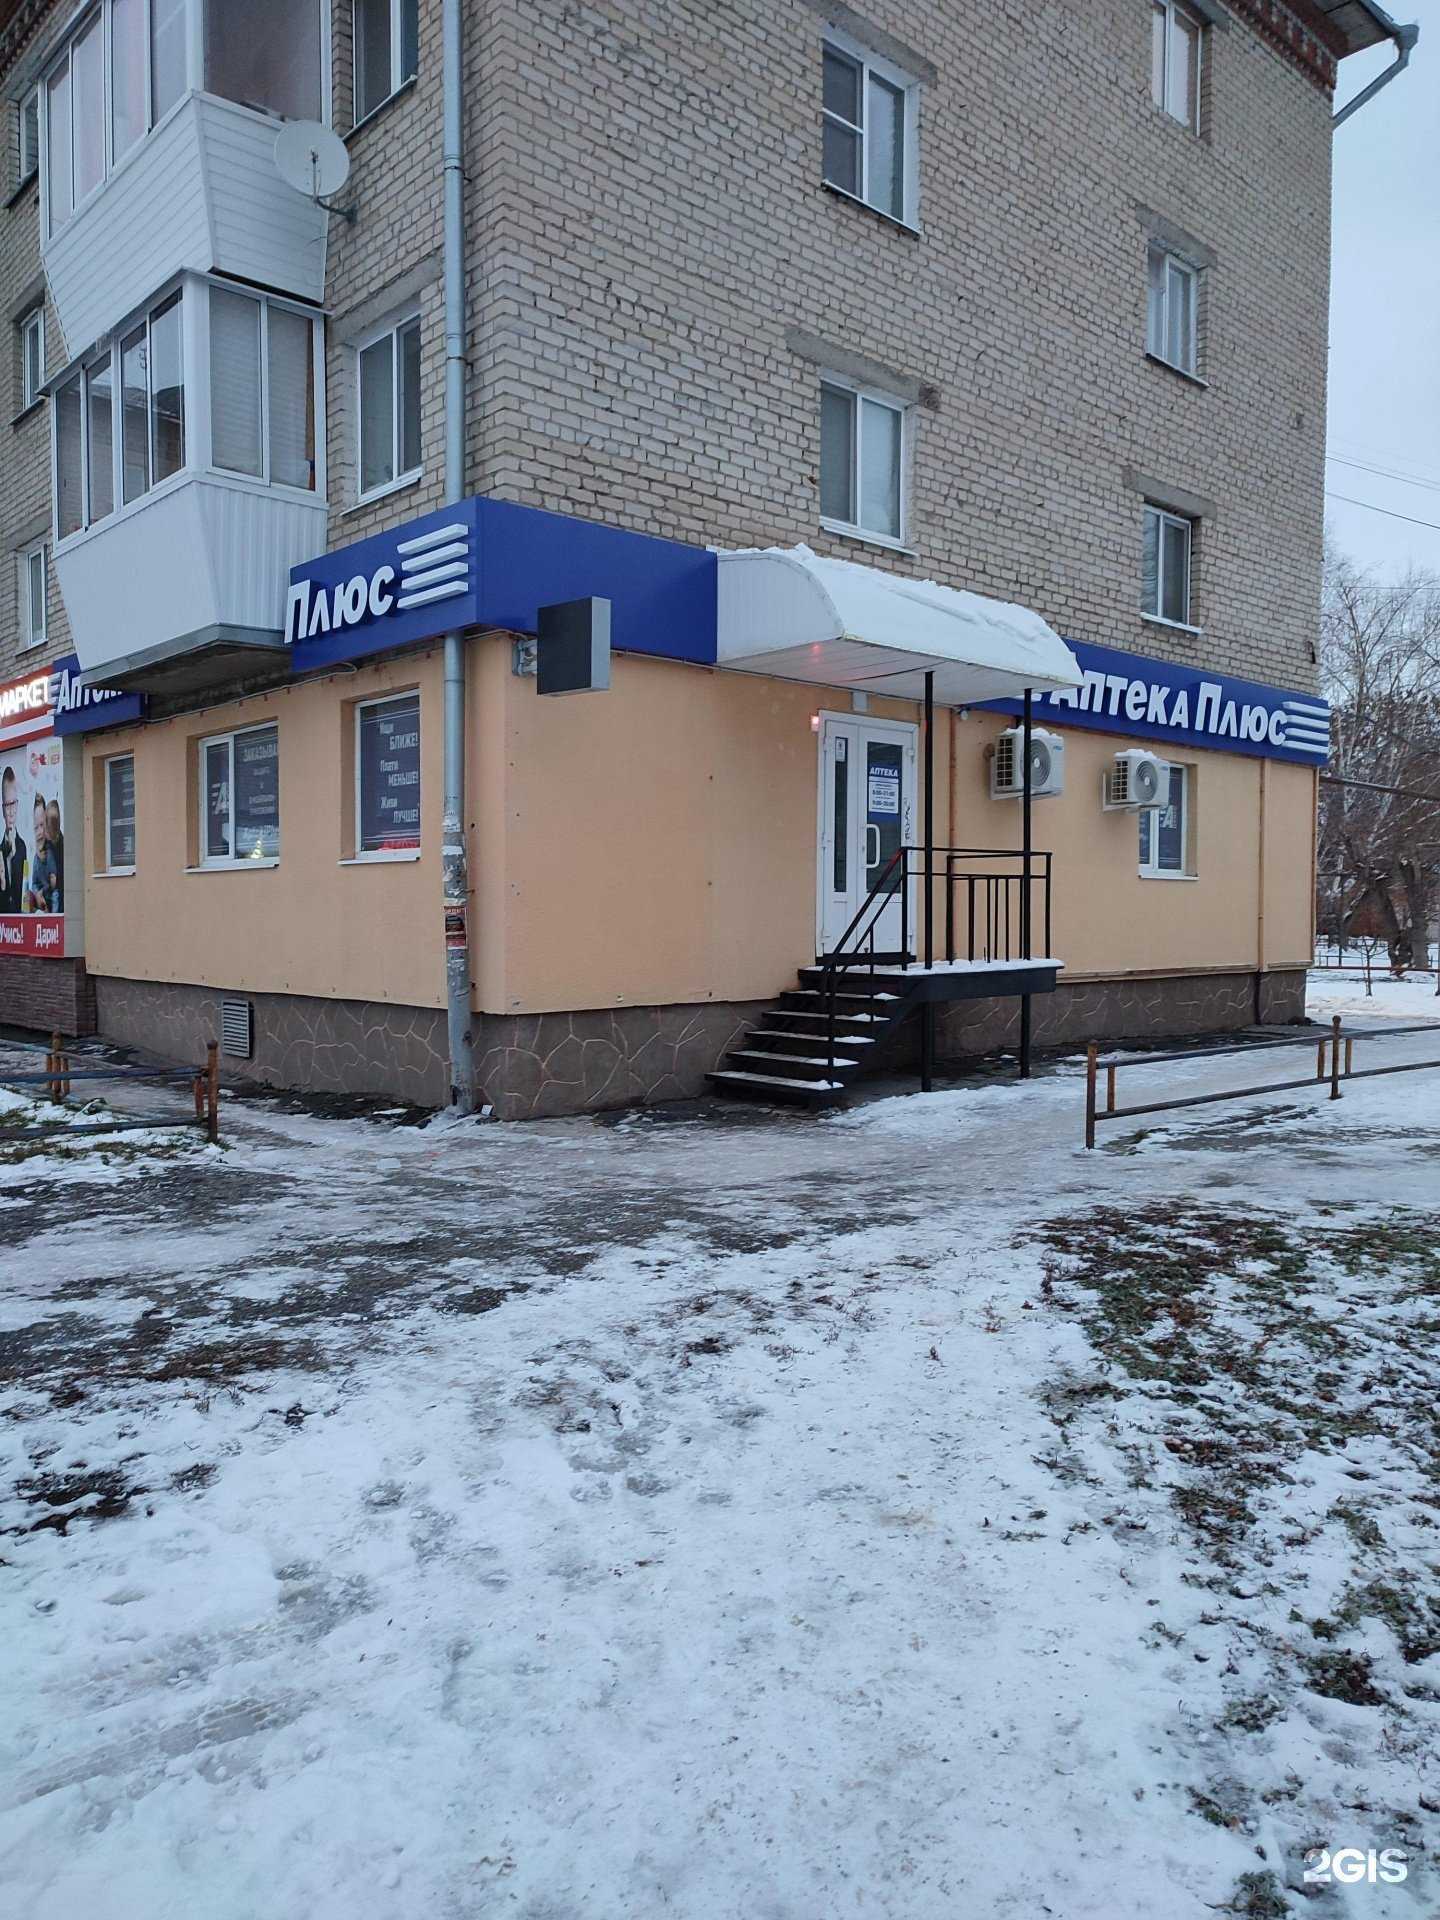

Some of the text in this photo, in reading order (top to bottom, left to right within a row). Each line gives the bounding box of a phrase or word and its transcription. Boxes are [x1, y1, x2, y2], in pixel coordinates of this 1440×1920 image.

[389, 732, 418, 751] БЛИЖЕ!
[388, 771, 418, 786] МЕНЬШЕ!
[870, 767, 898, 777] АПТЕКА
[35, 923, 59, 949] Дари!
